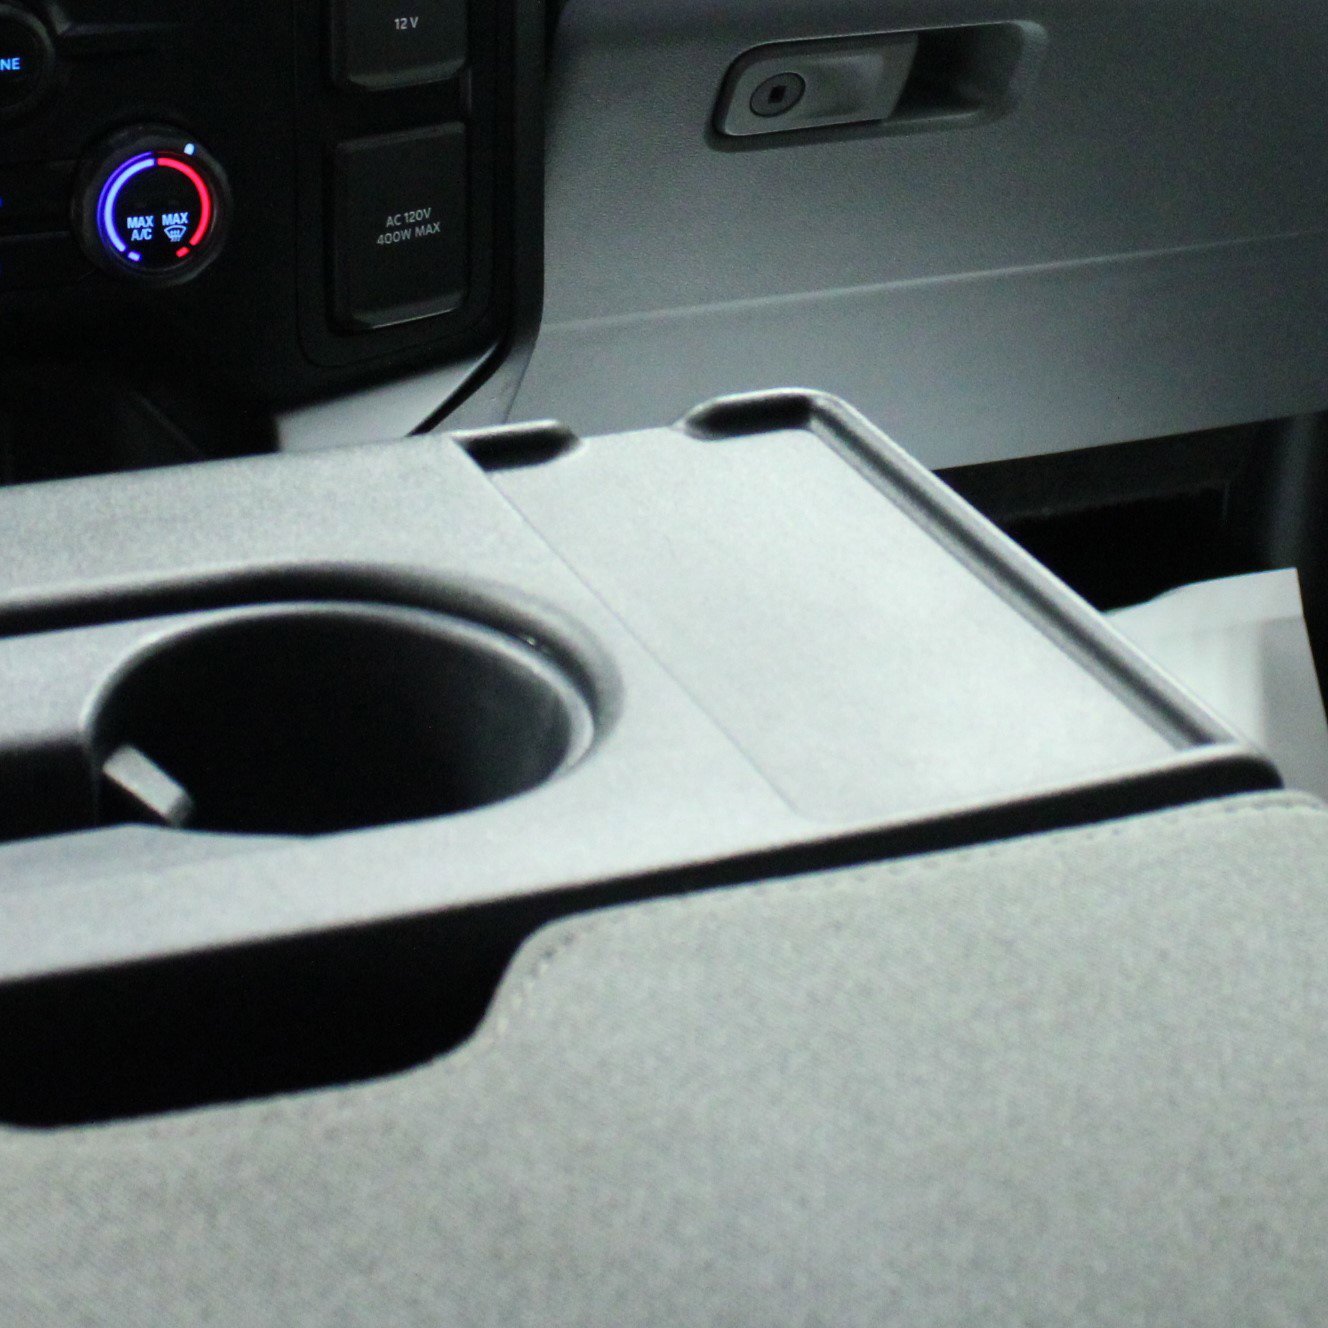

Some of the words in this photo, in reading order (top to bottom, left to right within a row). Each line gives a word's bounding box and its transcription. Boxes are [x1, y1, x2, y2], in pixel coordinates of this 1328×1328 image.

[393, 17, 408, 30] 12
[409, 16, 419, 28] V
[126, 215, 155, 230] MAX
[161, 211, 189, 226] MAX
[385, 213, 402, 228] AC
[403, 207, 432, 223] 120V
[131, 228, 153, 241] A/C
[376, 228, 412, 245] 400W
[414, 221, 441, 238] MAX
